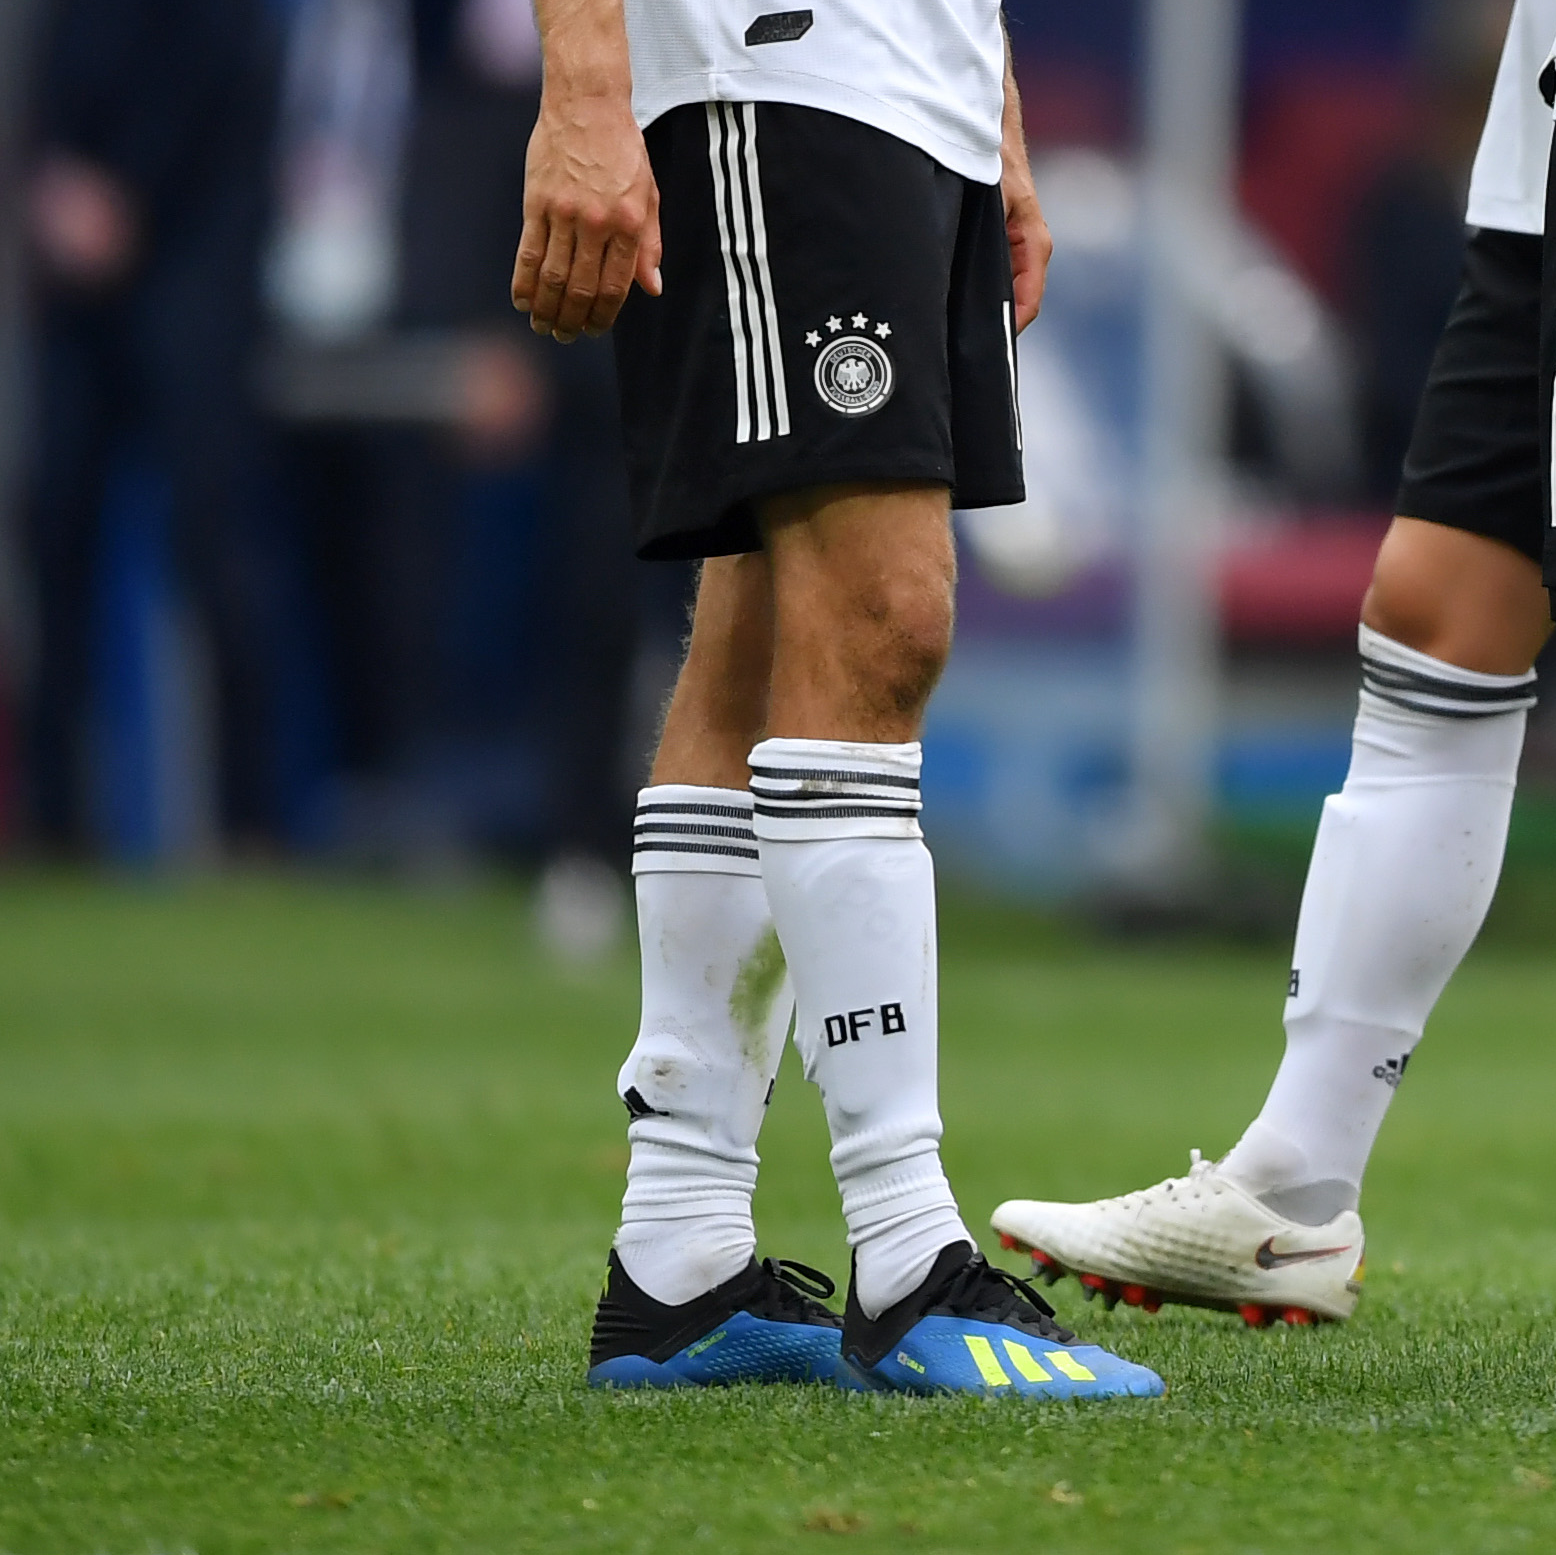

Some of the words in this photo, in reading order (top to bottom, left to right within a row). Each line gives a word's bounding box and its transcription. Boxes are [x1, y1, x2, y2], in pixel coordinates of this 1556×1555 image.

[829, 347, 872, 364] DEUTSCHER
[829, 381, 880, 403] FUSSBALL-BUND
[824, 1003, 906, 1047] DFB
